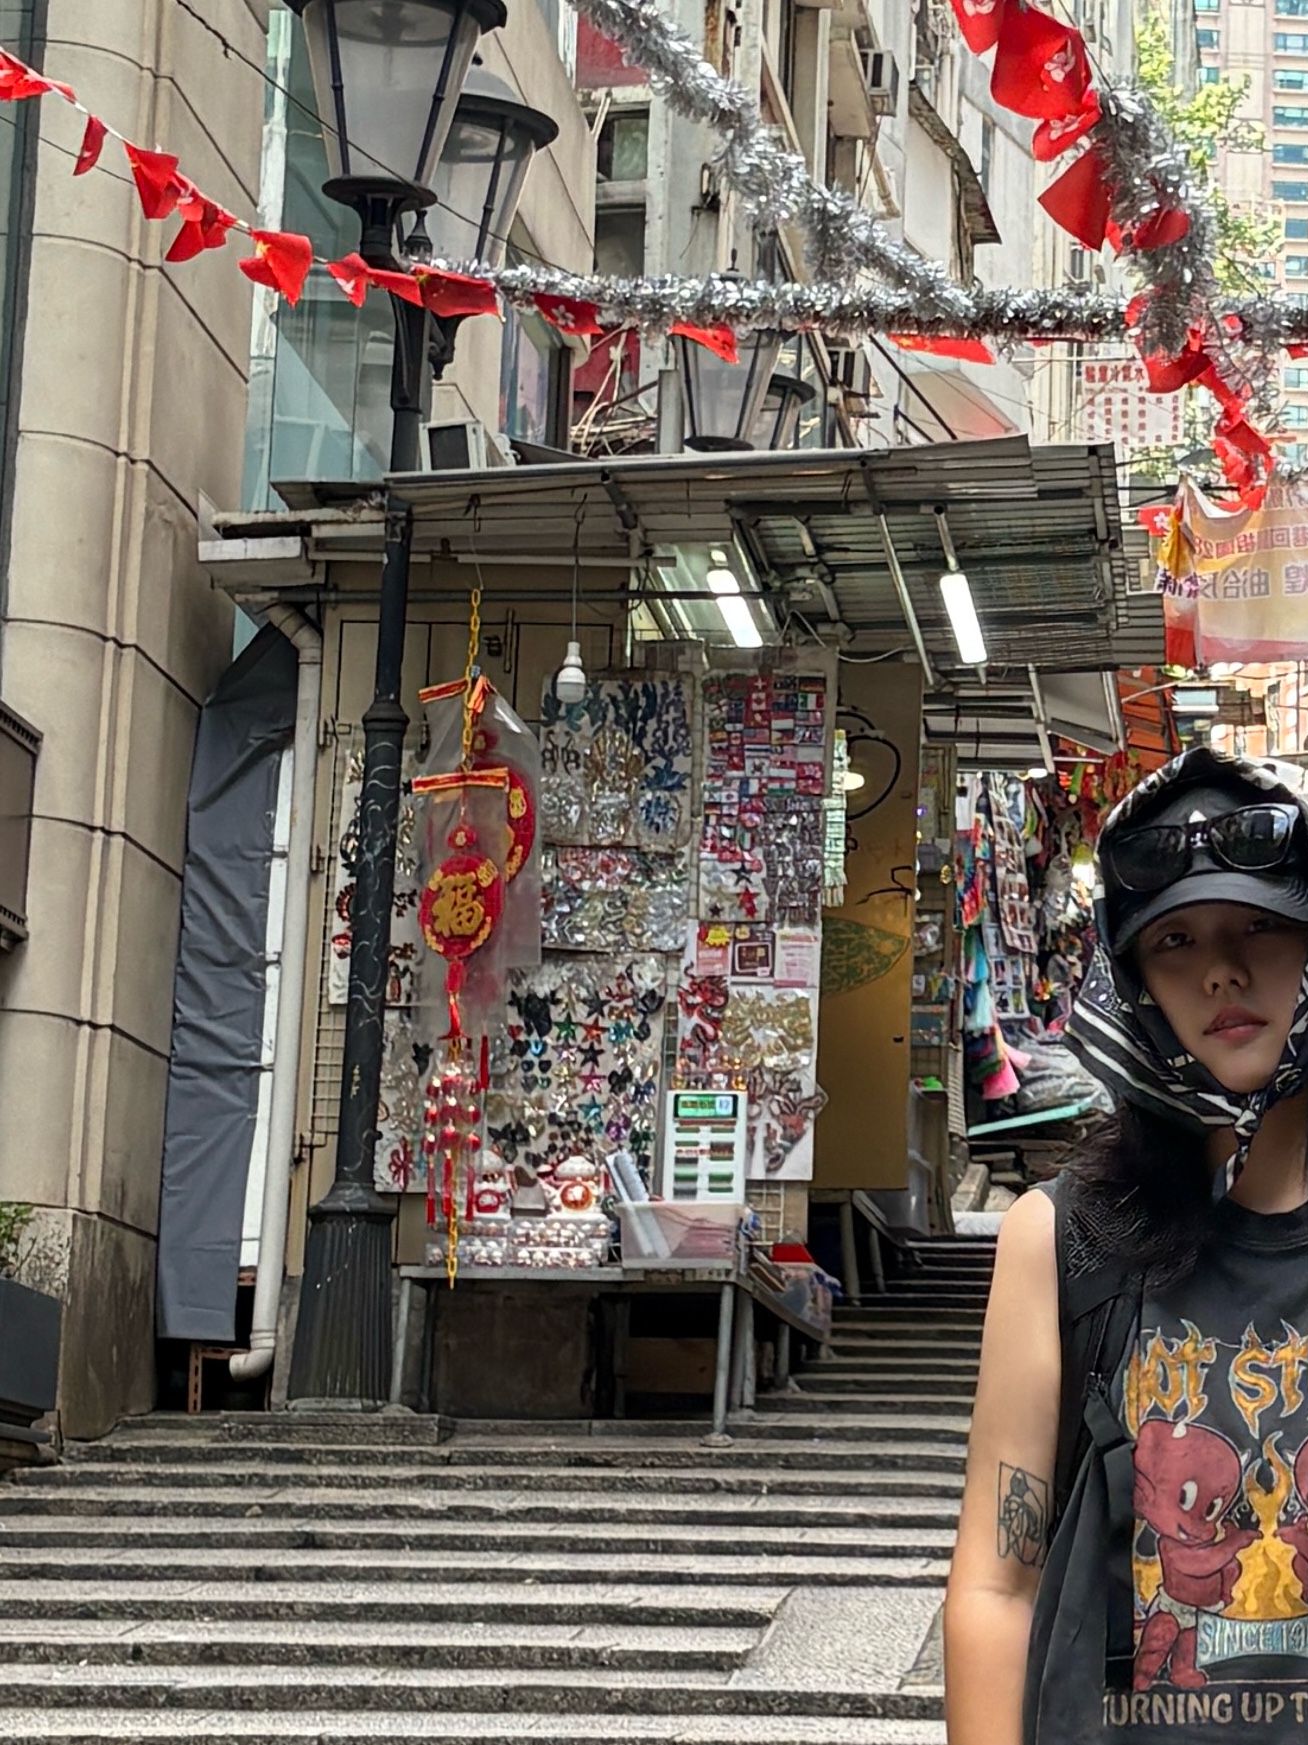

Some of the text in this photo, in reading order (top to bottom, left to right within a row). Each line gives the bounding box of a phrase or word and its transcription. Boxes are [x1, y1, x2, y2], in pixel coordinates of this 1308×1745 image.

[431, 872, 485, 937] 福
[1197, 1613, 1273, 1661] SINCE
[1241, 1691, 1285, 1725] UP
